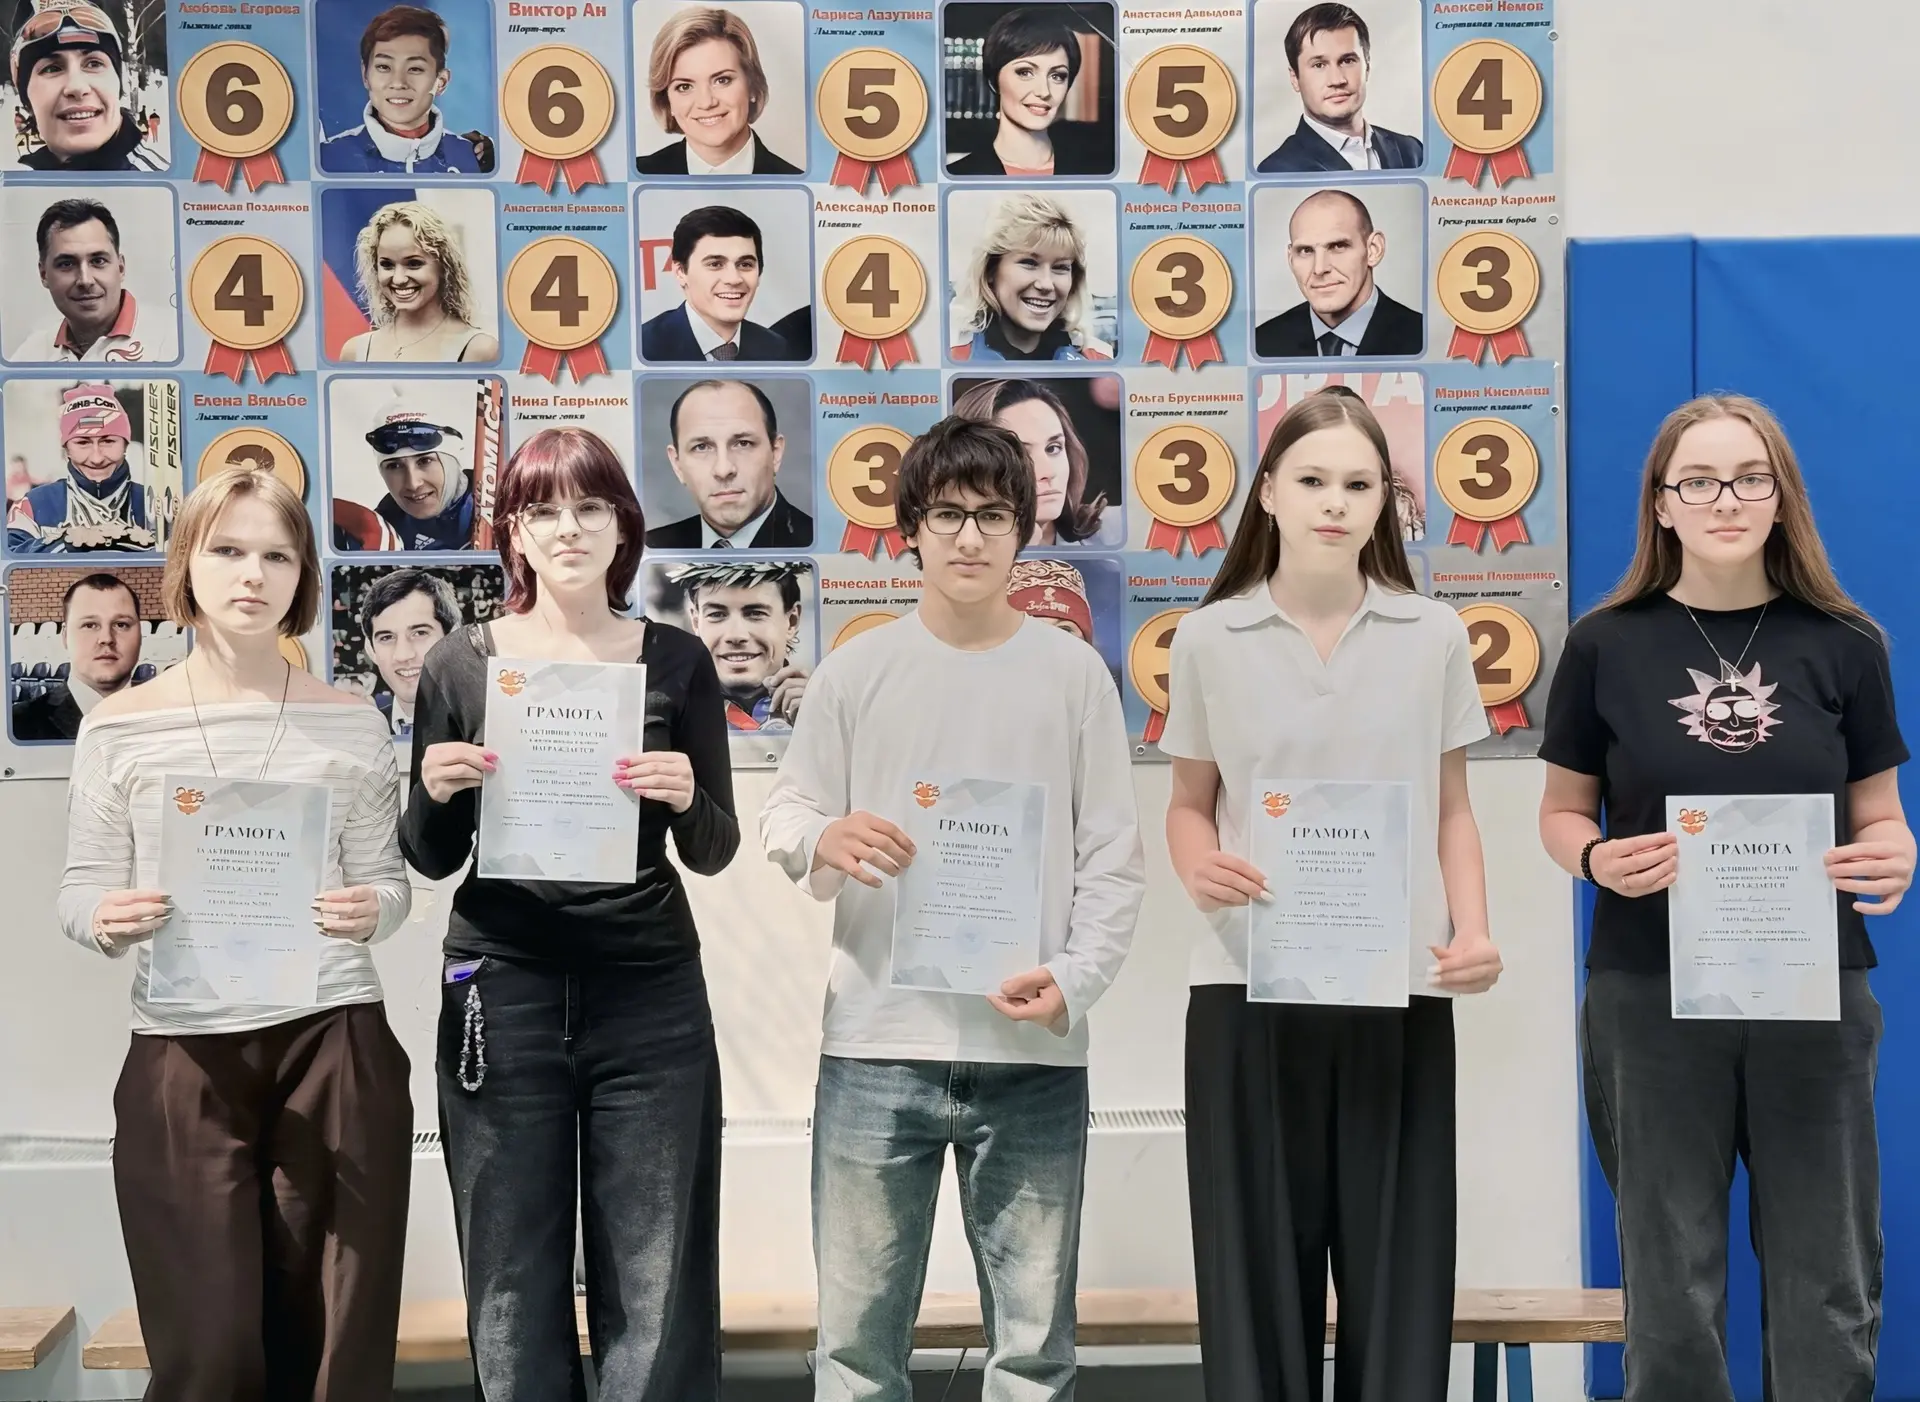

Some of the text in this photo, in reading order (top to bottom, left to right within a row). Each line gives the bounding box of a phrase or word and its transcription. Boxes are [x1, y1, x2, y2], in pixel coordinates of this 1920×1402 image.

[509, 2, 607, 20] Виктор Ан
[812, 8, 933, 22] Лариса Лазутина
[1123, 9, 1243, 19] Анастасия Давыдова
[205, 63, 263, 137] 6
[527, 65, 585, 138] 6
[1152, 65, 1209, 138] 5
[1456, 58, 1513, 131] 4
[844, 67, 900, 140] 5
[246, 202, 309, 212] Поздняков
[503, 203, 625, 214] Анастасия Ермакова
[815, 201, 936, 215] Александр Попов
[1124, 202, 1178, 215] Анфиса
[1431, 195, 1498, 207] Александр
[846, 252, 899, 318] 4
[1154, 251, 1206, 318] 3
[1459, 245, 1513, 313] 3
[214, 254, 274, 327] 4
[530, 255, 589, 327] 4
[194, 392, 307, 407] Елена Вяльбе
[819, 392, 939, 407] Андрей Лавров
[1129, 392, 1244, 405] Ольга Брусникина
[1435, 387, 1480, 400] Мария
[511, 395, 629, 409] Нина Гаврылюк
[149, 383, 159, 468] FISCHER
[167, 384, 177, 469] FISCHER
[852, 441, 902, 508] 3
[1157, 439, 1210, 505] 3
[1459, 434, 1512, 500] 3
[821, 578, 887, 590] Вячеслав
[823, 596, 887, 605] Велосипедный
[1469, 620, 1512, 685] 2
[527, 706, 603, 720] ГРАМОТА
[205, 825, 285, 840] ГРАМОТА
[939, 819, 1008, 836] ГРАМОТА
[1293, 827, 1370, 840] ГРАМОТА
[1711, 843, 1792, 855] ГРАМОТА
